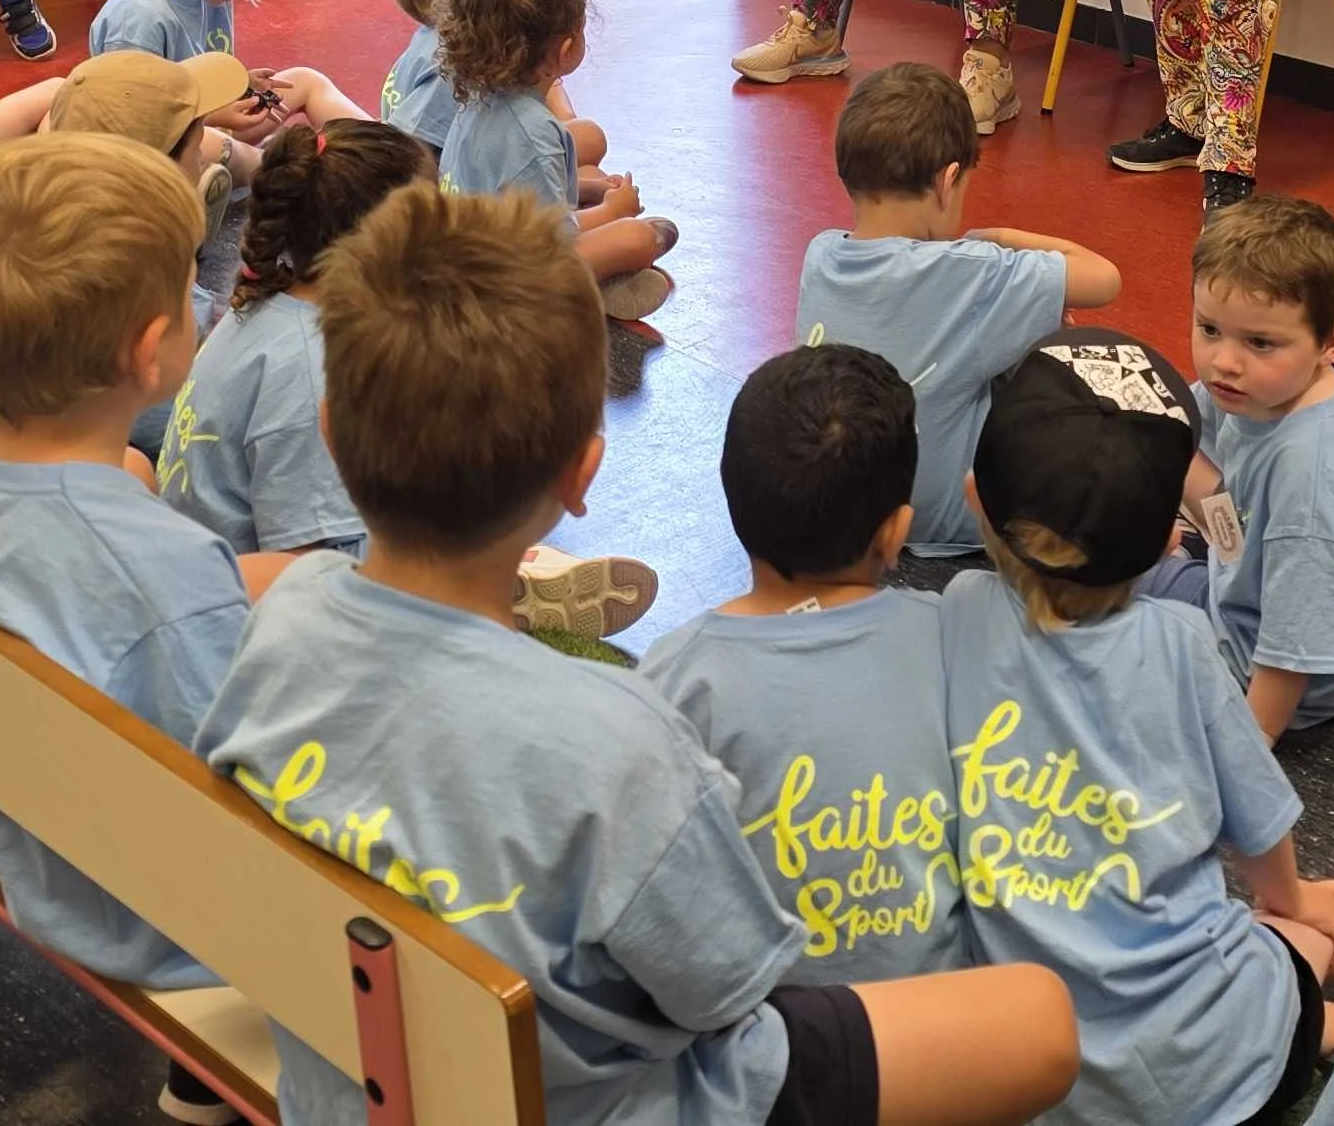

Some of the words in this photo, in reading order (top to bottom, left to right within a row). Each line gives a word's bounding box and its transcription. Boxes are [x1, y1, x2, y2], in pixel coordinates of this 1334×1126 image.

[741, 755, 957, 880] faites
[951, 700, 1183, 844] faites
[847, 849, 905, 898] du
[962, 825, 1142, 912] Sport
[1016, 812, 1073, 860] du
[796, 852, 960, 958] Sport
